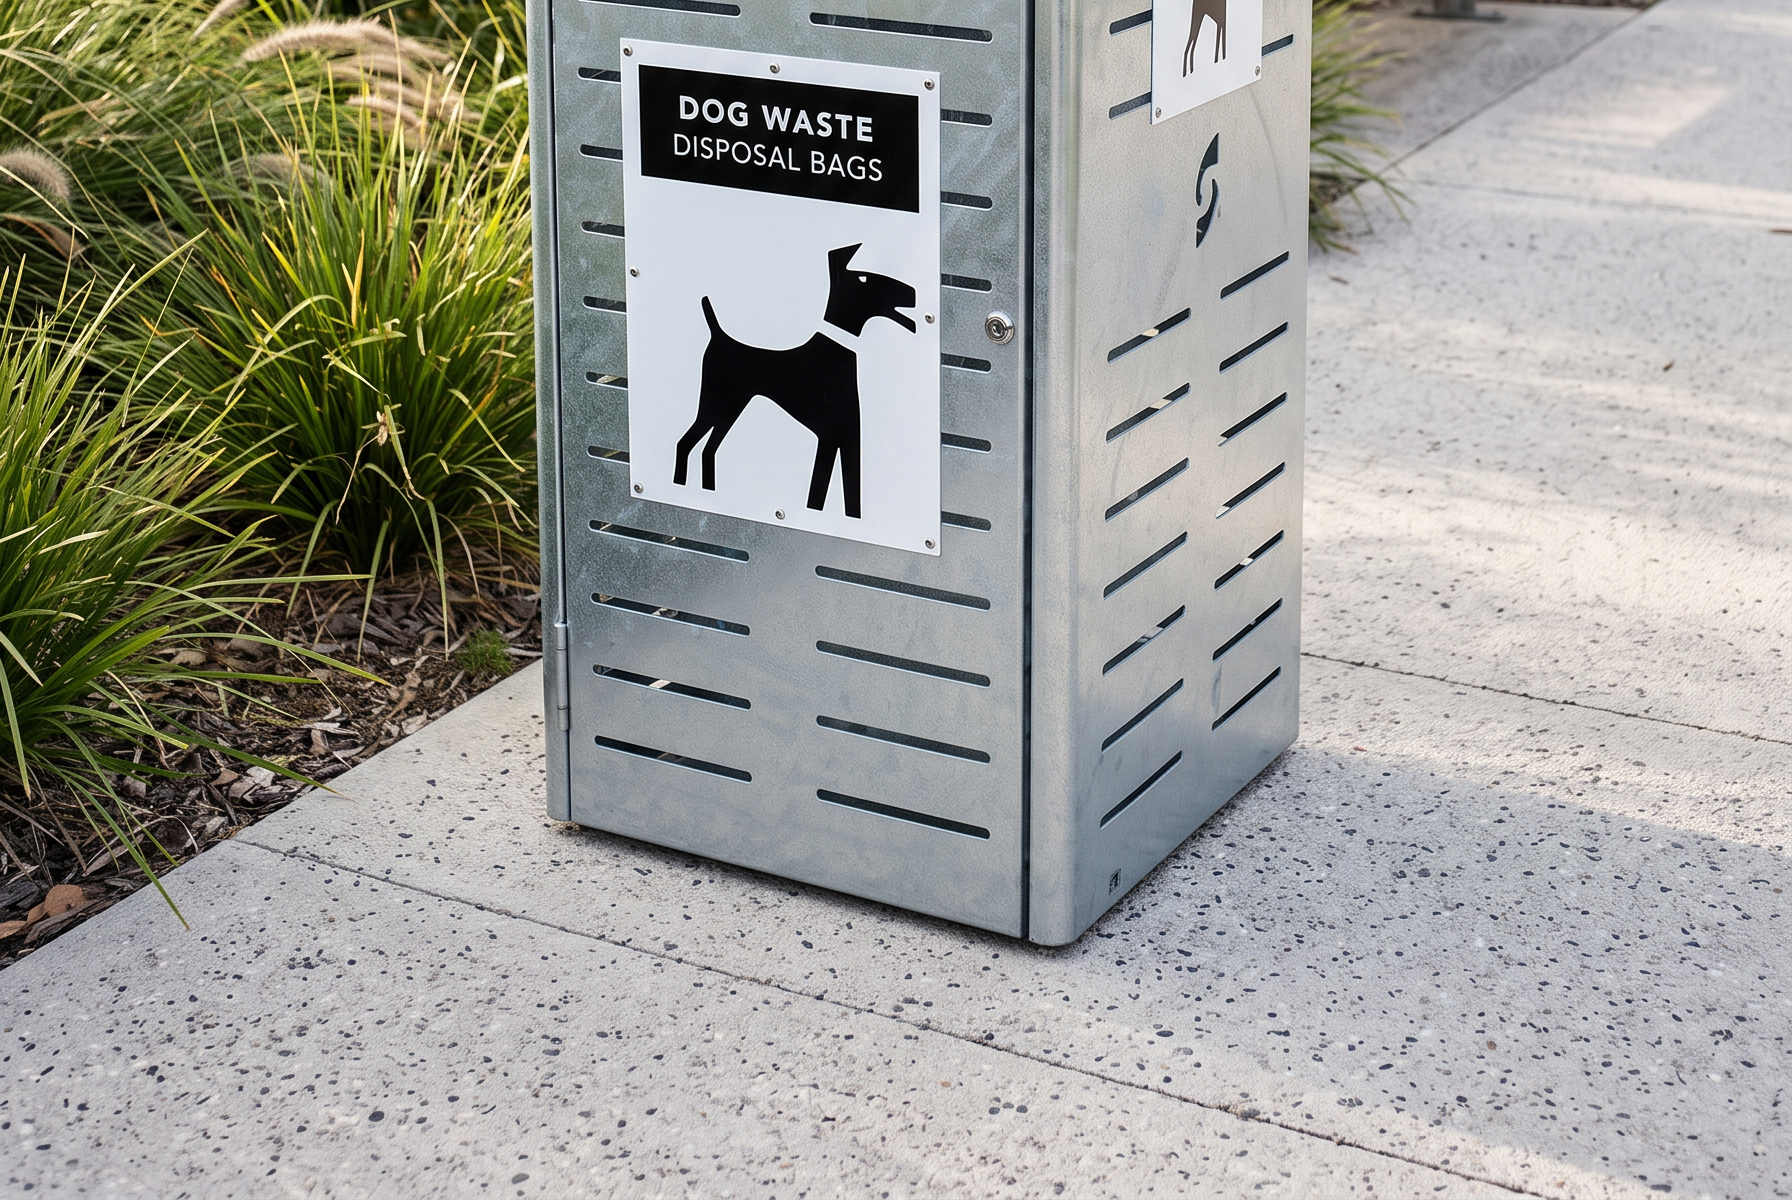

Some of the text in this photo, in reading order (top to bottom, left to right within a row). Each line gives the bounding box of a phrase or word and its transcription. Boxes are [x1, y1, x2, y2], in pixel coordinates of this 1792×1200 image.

[679, 95, 873, 143] DOG WASTE
[673, 133, 883, 182] DISPOSAL BAGS
